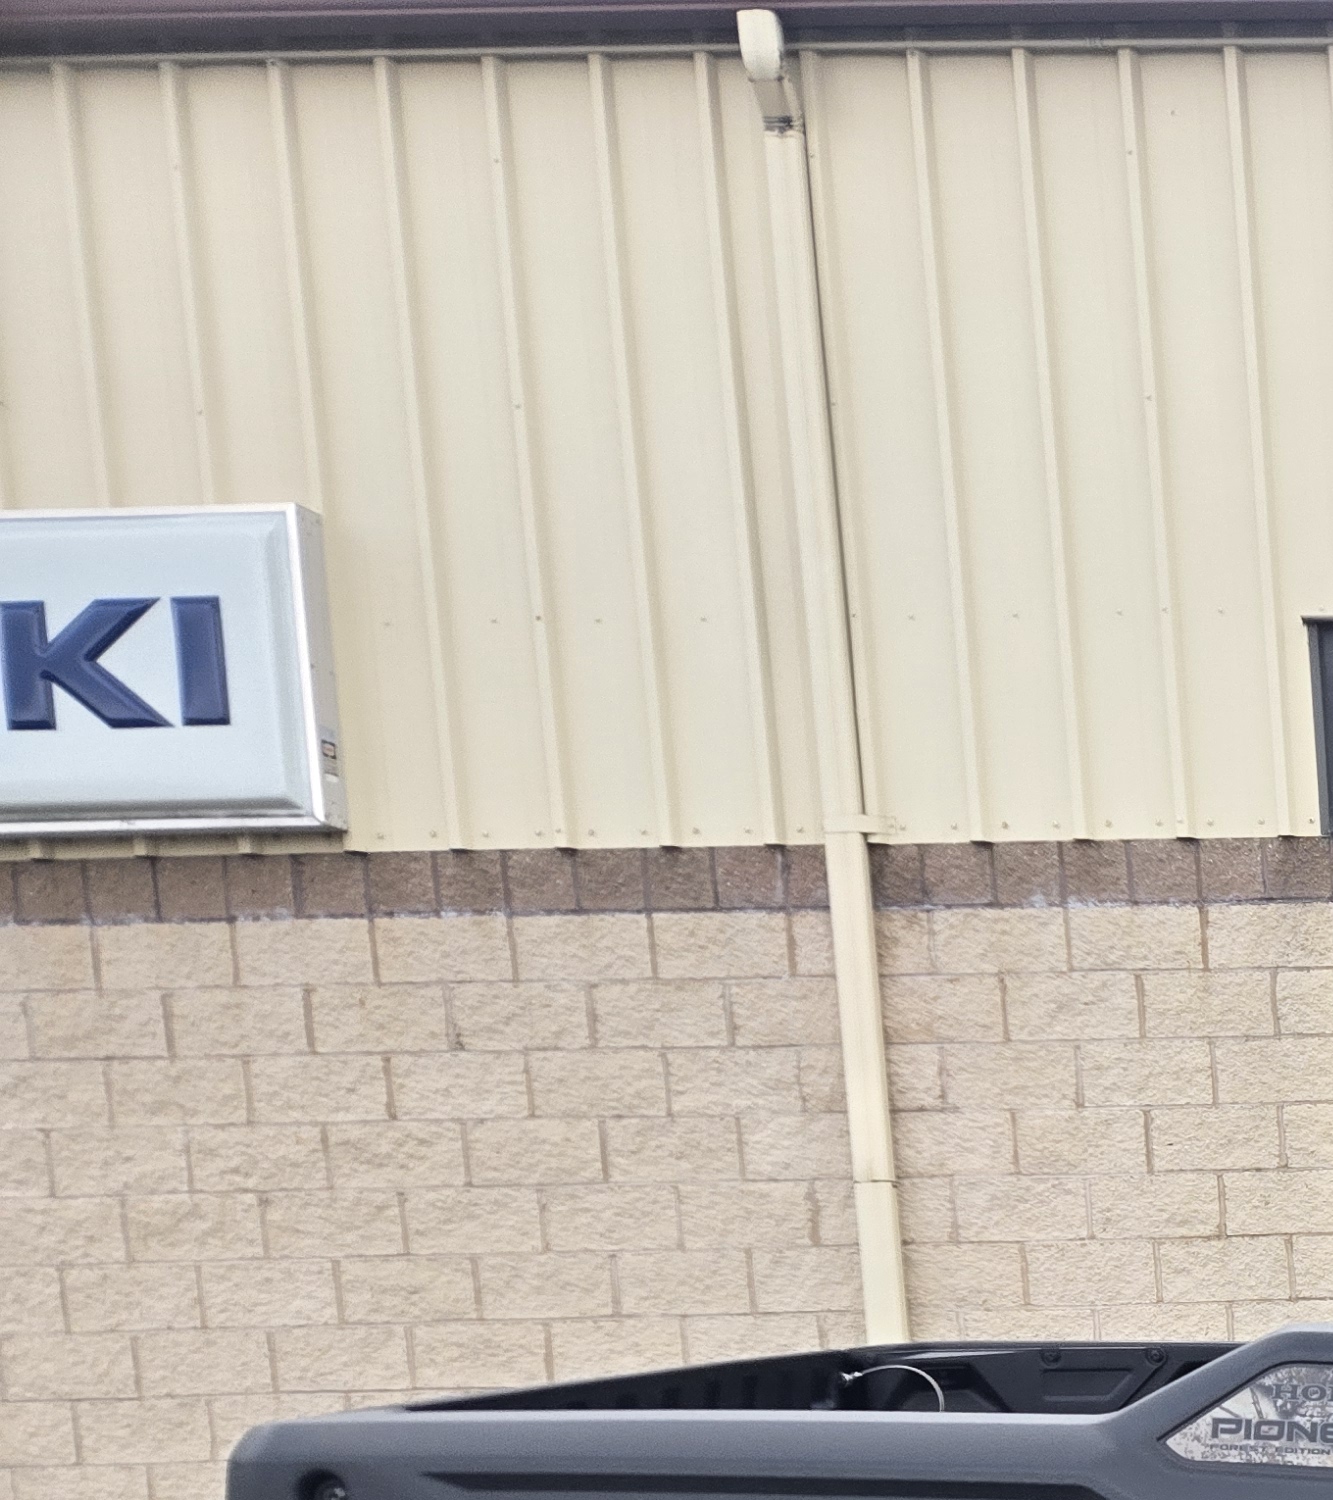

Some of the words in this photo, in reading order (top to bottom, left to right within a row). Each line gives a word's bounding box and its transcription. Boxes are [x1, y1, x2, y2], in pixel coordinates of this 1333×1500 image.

[0, 594, 231, 731] KI
[1209, 1443, 1266, 1453] FOREST
[1275, 1446, 1331, 1456] EDITION
